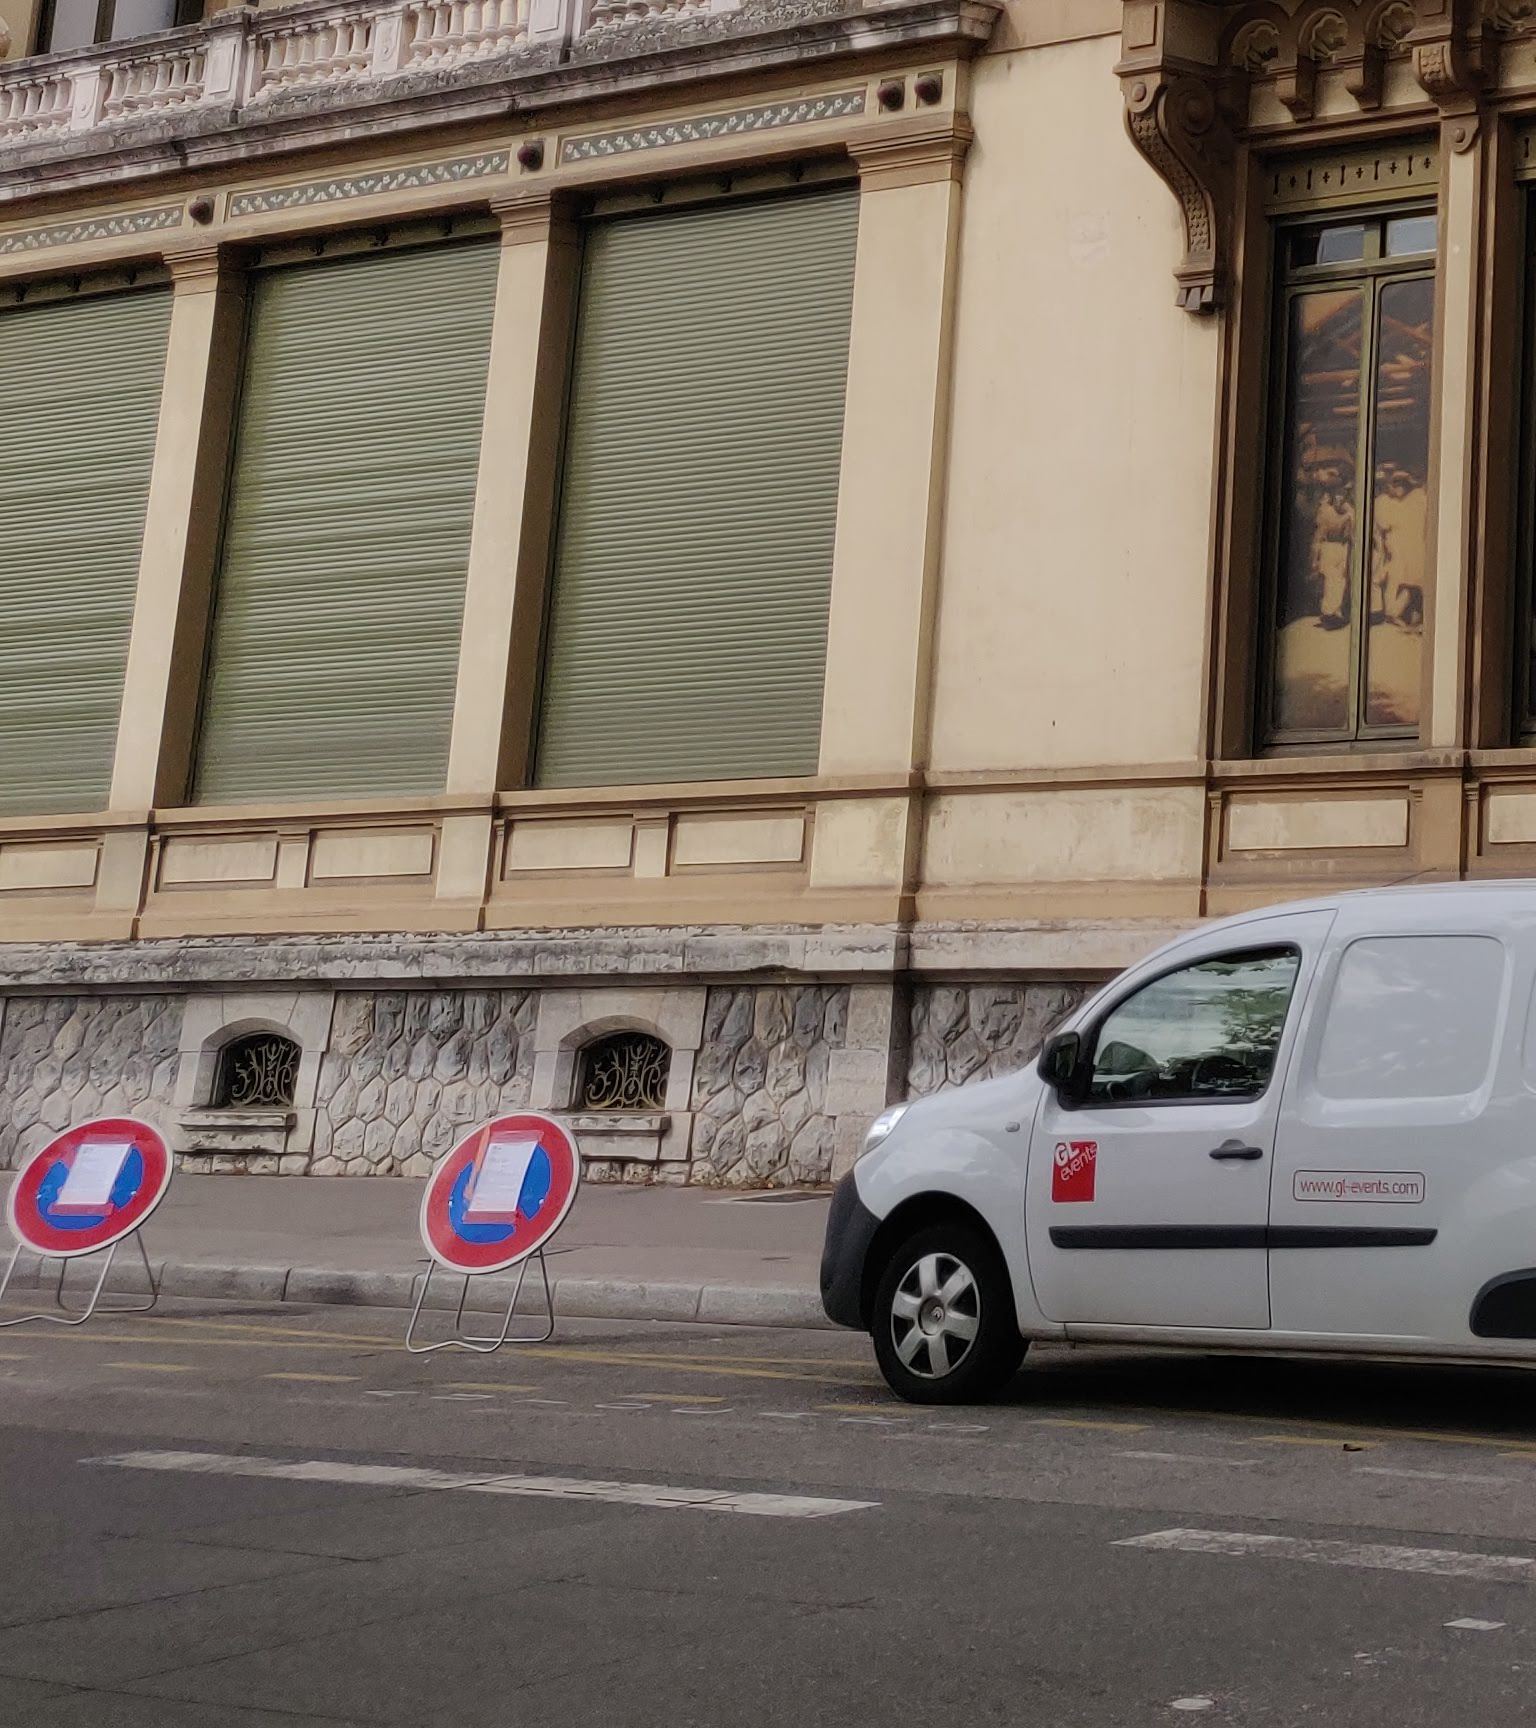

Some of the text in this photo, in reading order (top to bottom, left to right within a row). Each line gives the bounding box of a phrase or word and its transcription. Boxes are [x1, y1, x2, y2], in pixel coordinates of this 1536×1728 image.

[1055, 1142, 1080, 1167] GL
[1061, 1144, 1096, 1181] events
[1300, 1179, 1419, 1198] www.gl-events.com
